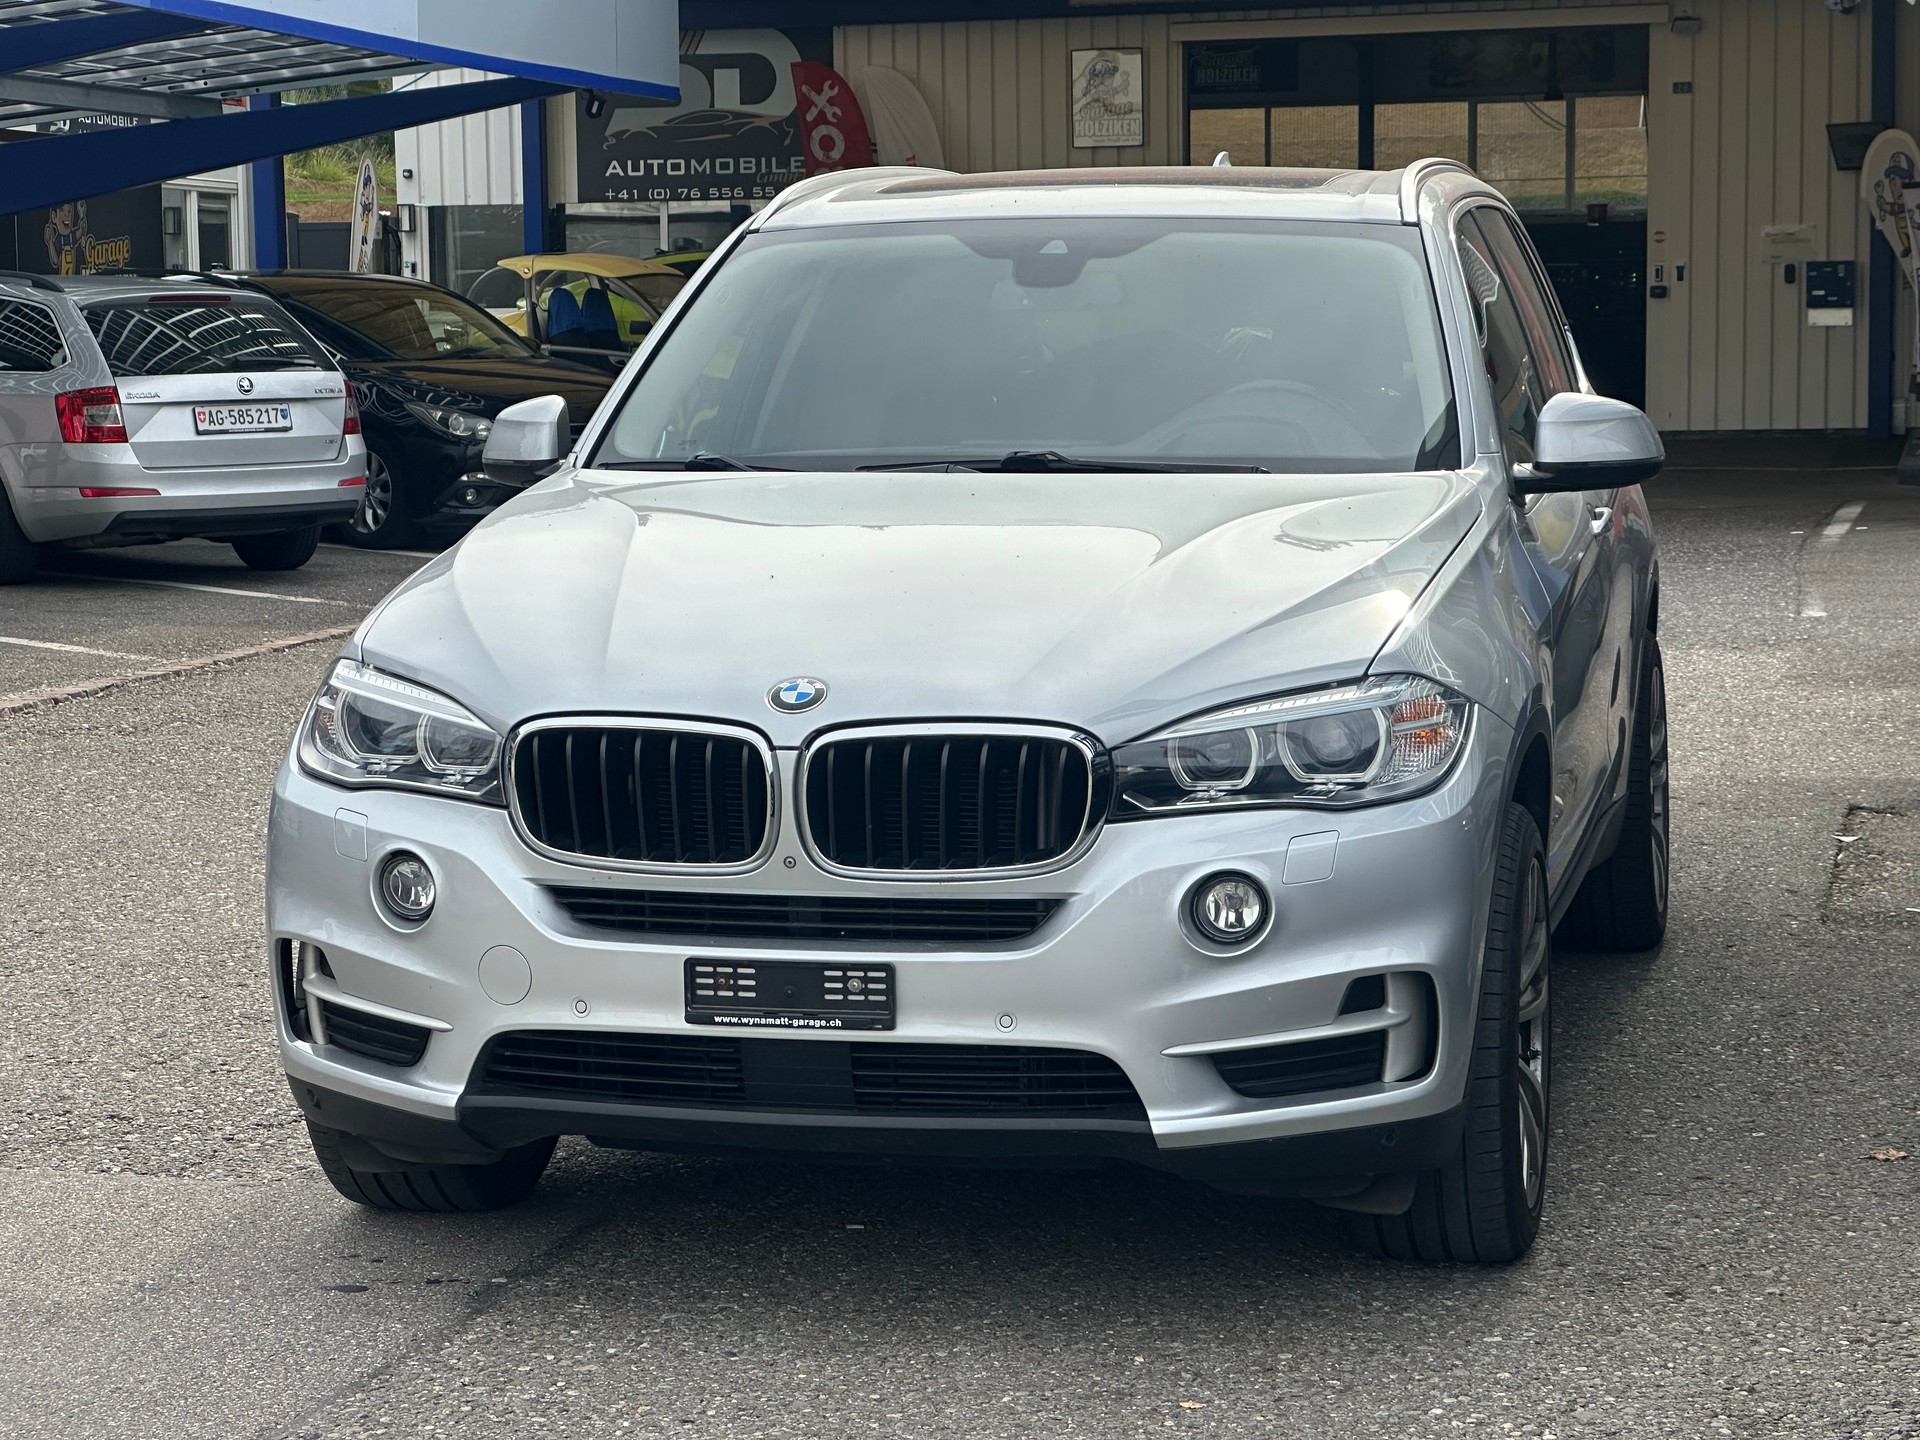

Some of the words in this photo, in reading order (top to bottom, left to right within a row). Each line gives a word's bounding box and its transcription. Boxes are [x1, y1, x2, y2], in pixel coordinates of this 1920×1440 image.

[1074, 119, 1140, 137] HOLZIKEN
[604, 155, 806, 177] AUTOMOBILE
[605, 188, 638, 200] +41
[648, 188, 670, 200] (0)
[677, 187, 701, 198] 76
[709, 187, 744, 198] 556
[84, 235, 130, 271] Garage
[714, 1015, 842, 1027] www.wynamatt-garage.ch
